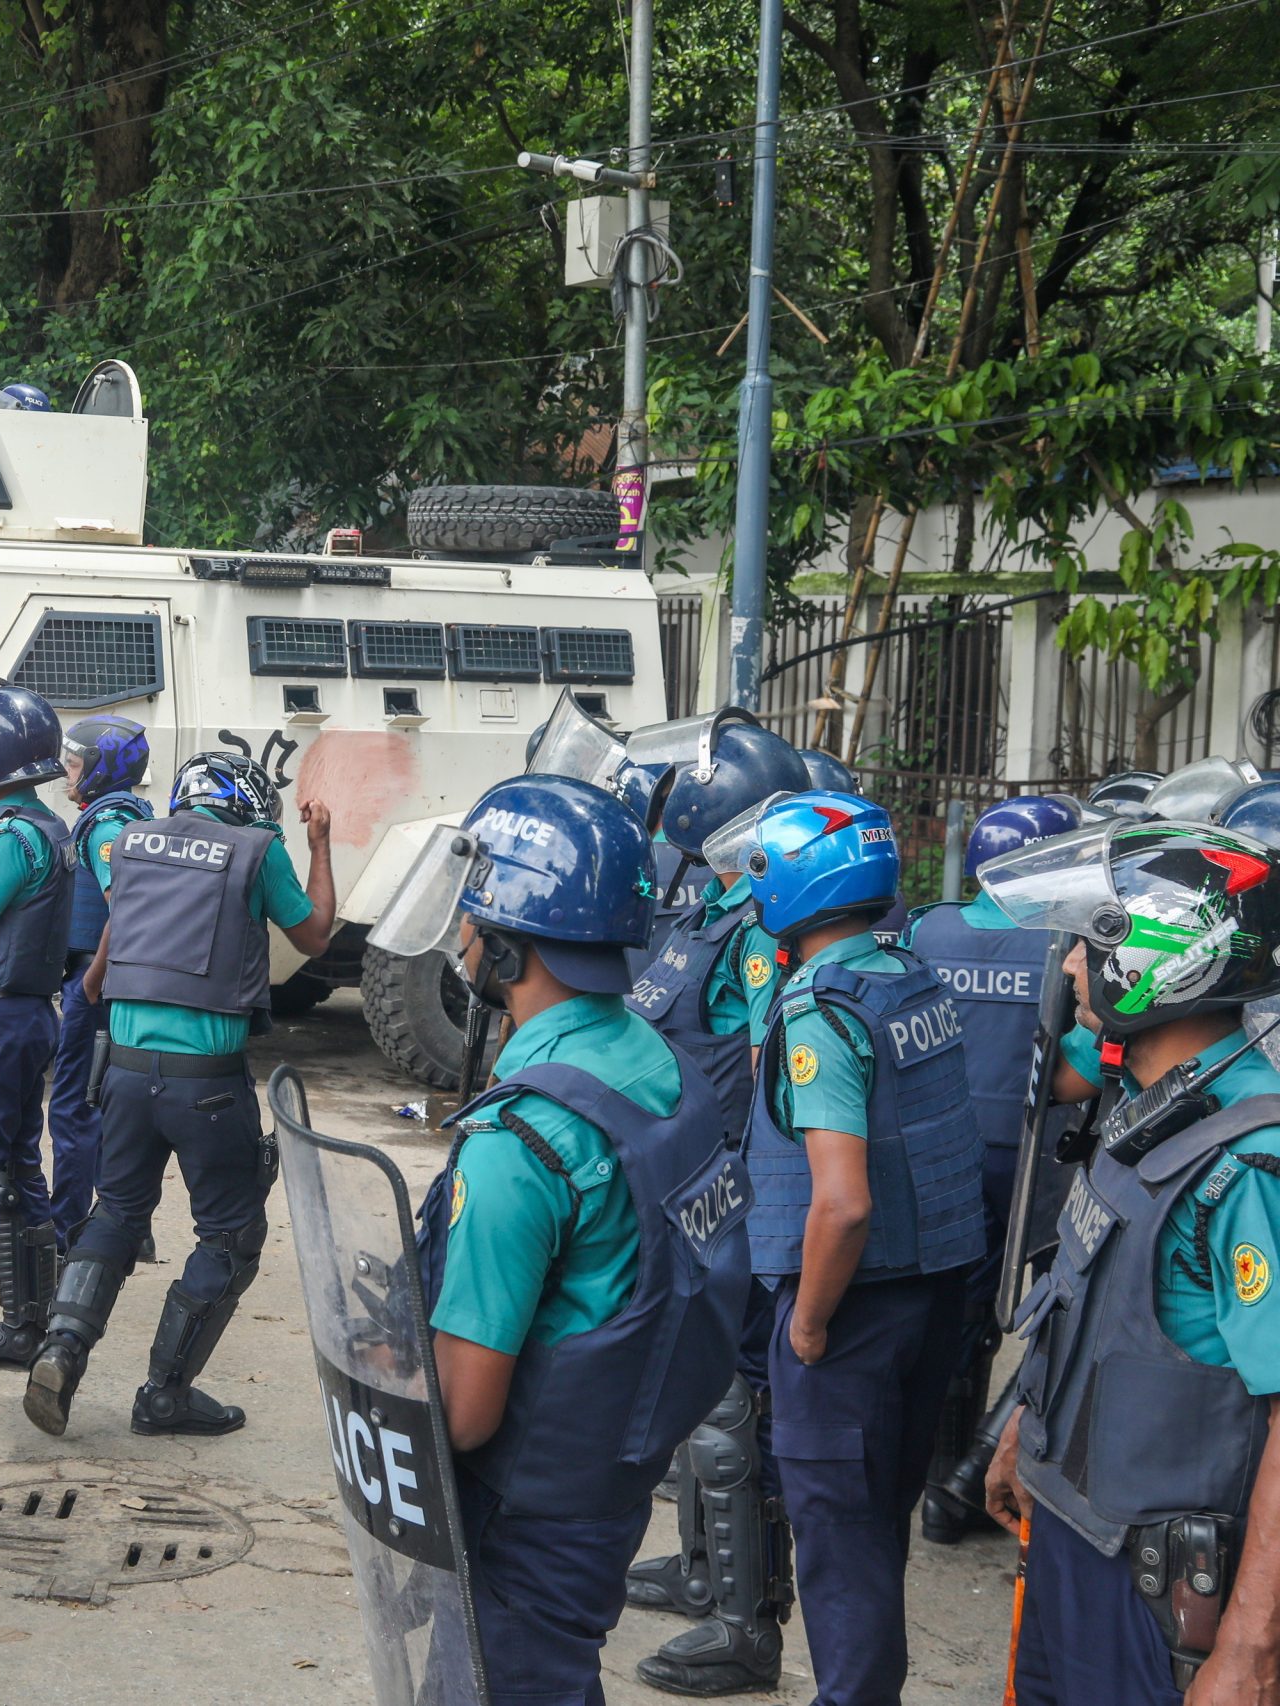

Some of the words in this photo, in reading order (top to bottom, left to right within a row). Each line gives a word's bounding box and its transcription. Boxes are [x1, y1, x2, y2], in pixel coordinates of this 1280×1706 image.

[24, 396, 44, 407] POLICE
[124, 833, 229, 865] POLICE
[479, 807, 556, 848] POLICE
[1151, 916, 1240, 985] SPLITTER
[937, 967, 1031, 997] POLICE
[888, 998, 963, 1060] POLICE
[680, 1162, 743, 1253] POLICE
[1064, 1177, 1111, 1256] POLICE
